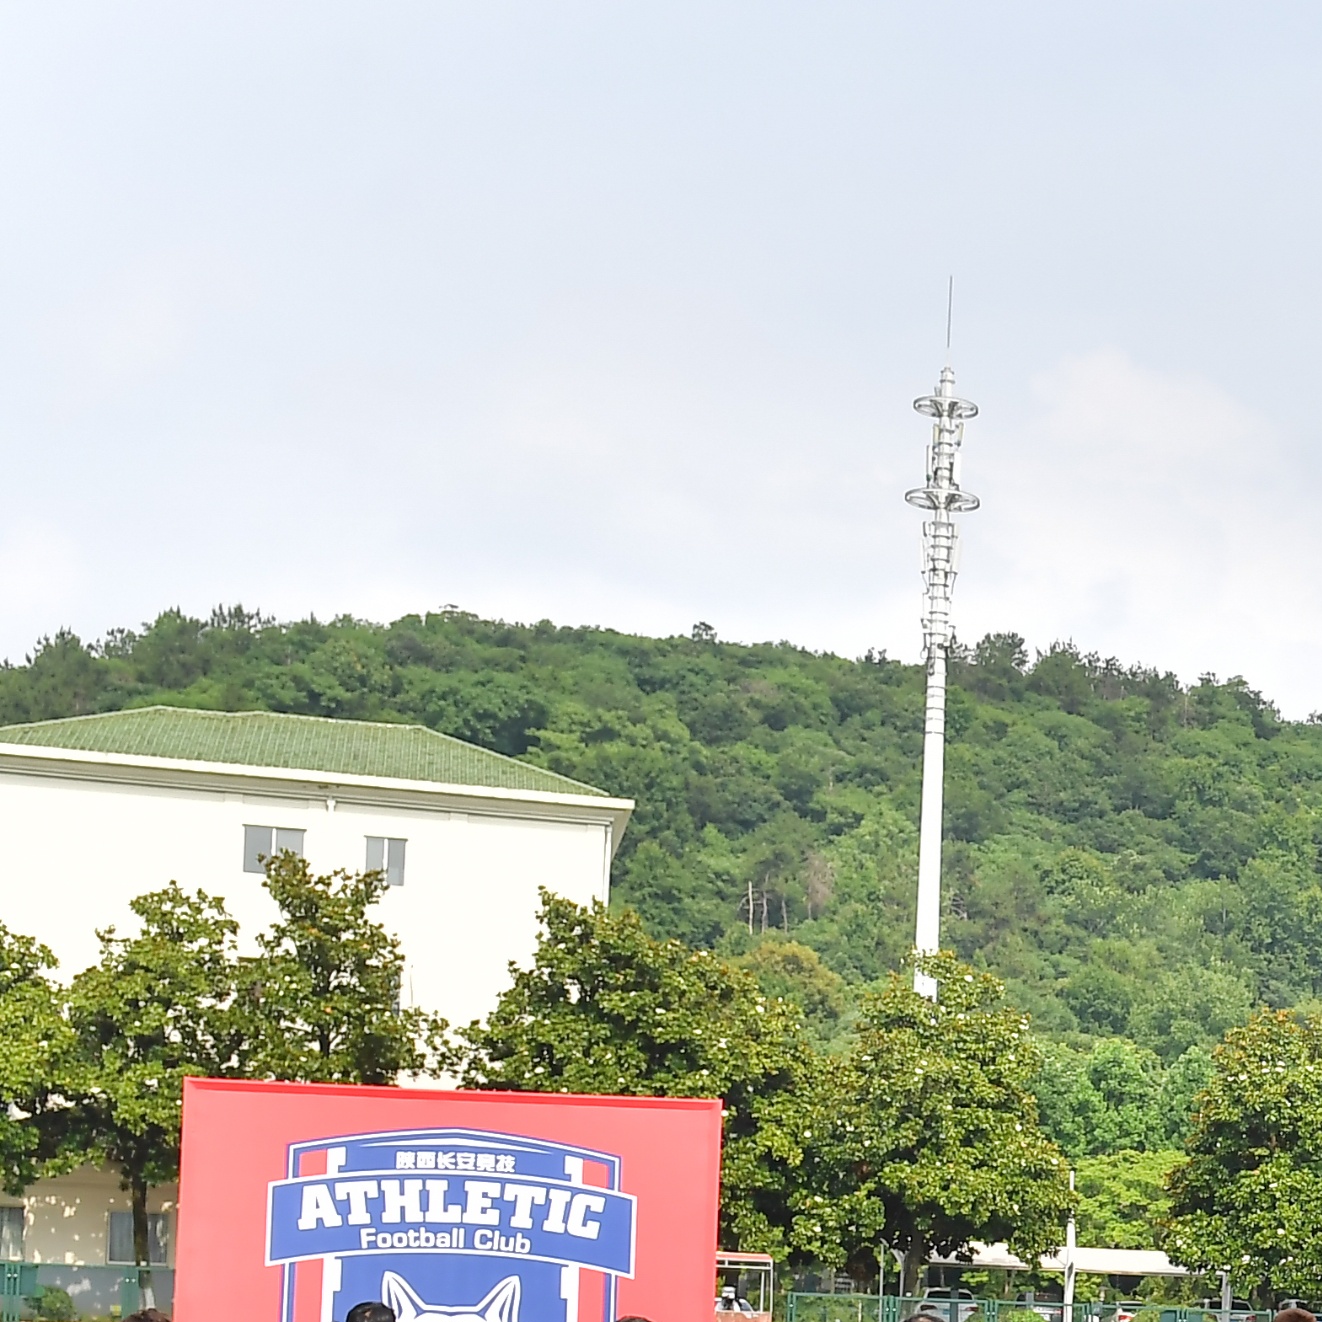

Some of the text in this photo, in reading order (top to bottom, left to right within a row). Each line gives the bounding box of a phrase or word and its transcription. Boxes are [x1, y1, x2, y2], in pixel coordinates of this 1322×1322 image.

[297, 1178, 606, 1240] ATHLETIC
[360, 1227, 532, 1254] Football Club
